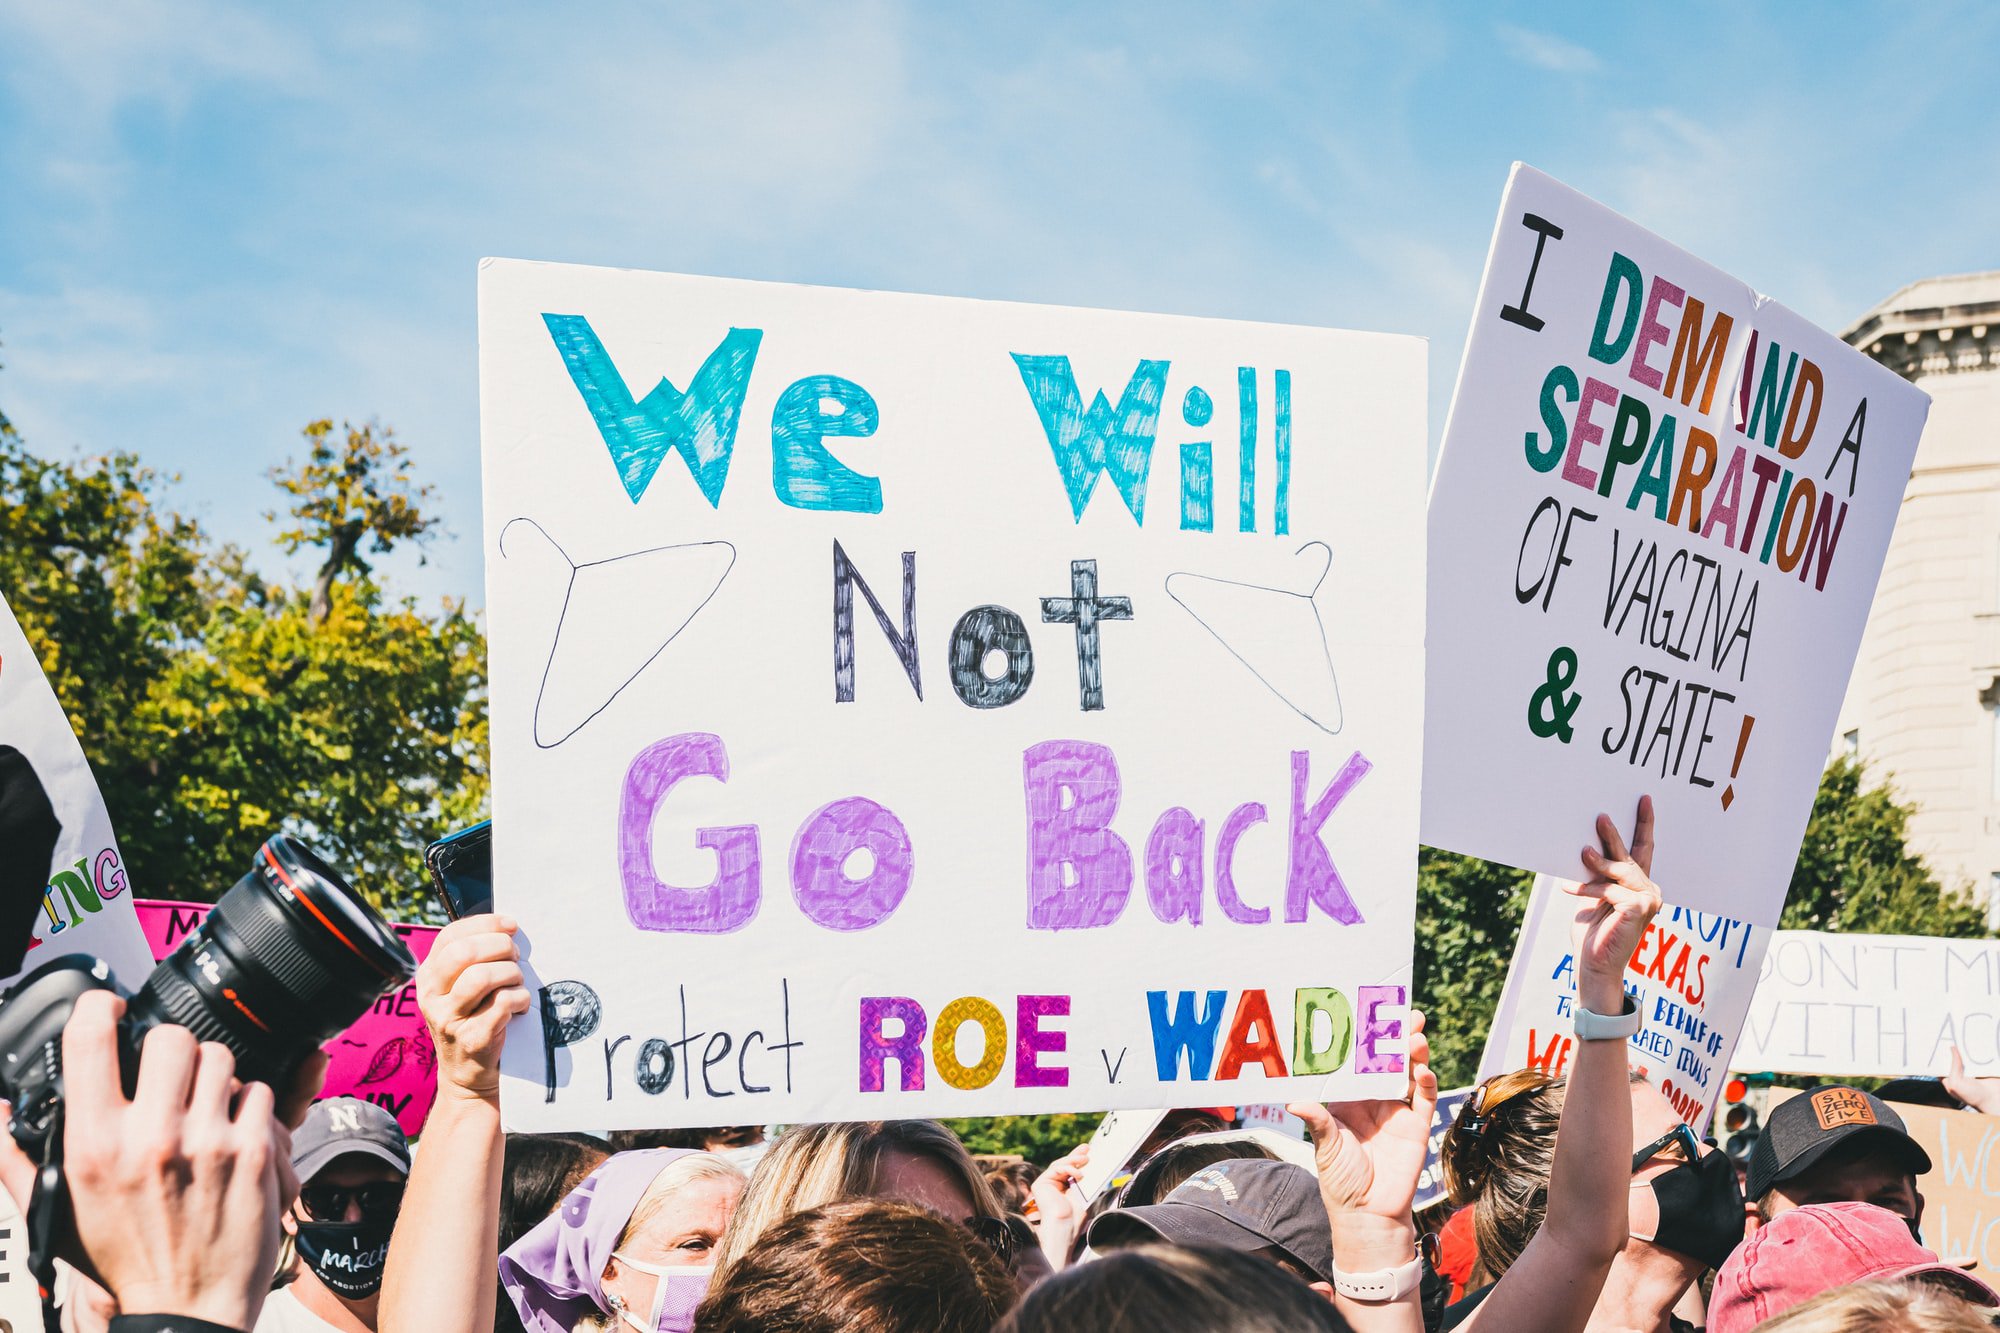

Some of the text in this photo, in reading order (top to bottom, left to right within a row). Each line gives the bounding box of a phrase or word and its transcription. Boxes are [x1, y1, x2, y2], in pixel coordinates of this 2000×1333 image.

[1500, 213, 1564, 332] I
[1825, 397, 1867, 497] A
[541, 312, 1292, 536] We Will
[1524, 365, 1848, 592] SEPARATION
[833, 538, 1134, 712] Not
[1515, 496, 1759, 682] OF VAGINA
[1528, 646, 1582, 744] &
[617, 732, 915, 936] Go
[1628, 923, 1710, 1013] EXAS,
[537, 978, 804, 1104] Protect
[860, 995, 1071, 1092] ROE
[1146, 986, 1406, 1082] WADE
[1707, 1032, 1723, 1057] OF
[328, 1105, 361, 1132] N
[1823, 1092, 1857, 1104] SIX
[1823, 1099, 1866, 1115] ZERO
[353, 1236, 358, 1250] I
